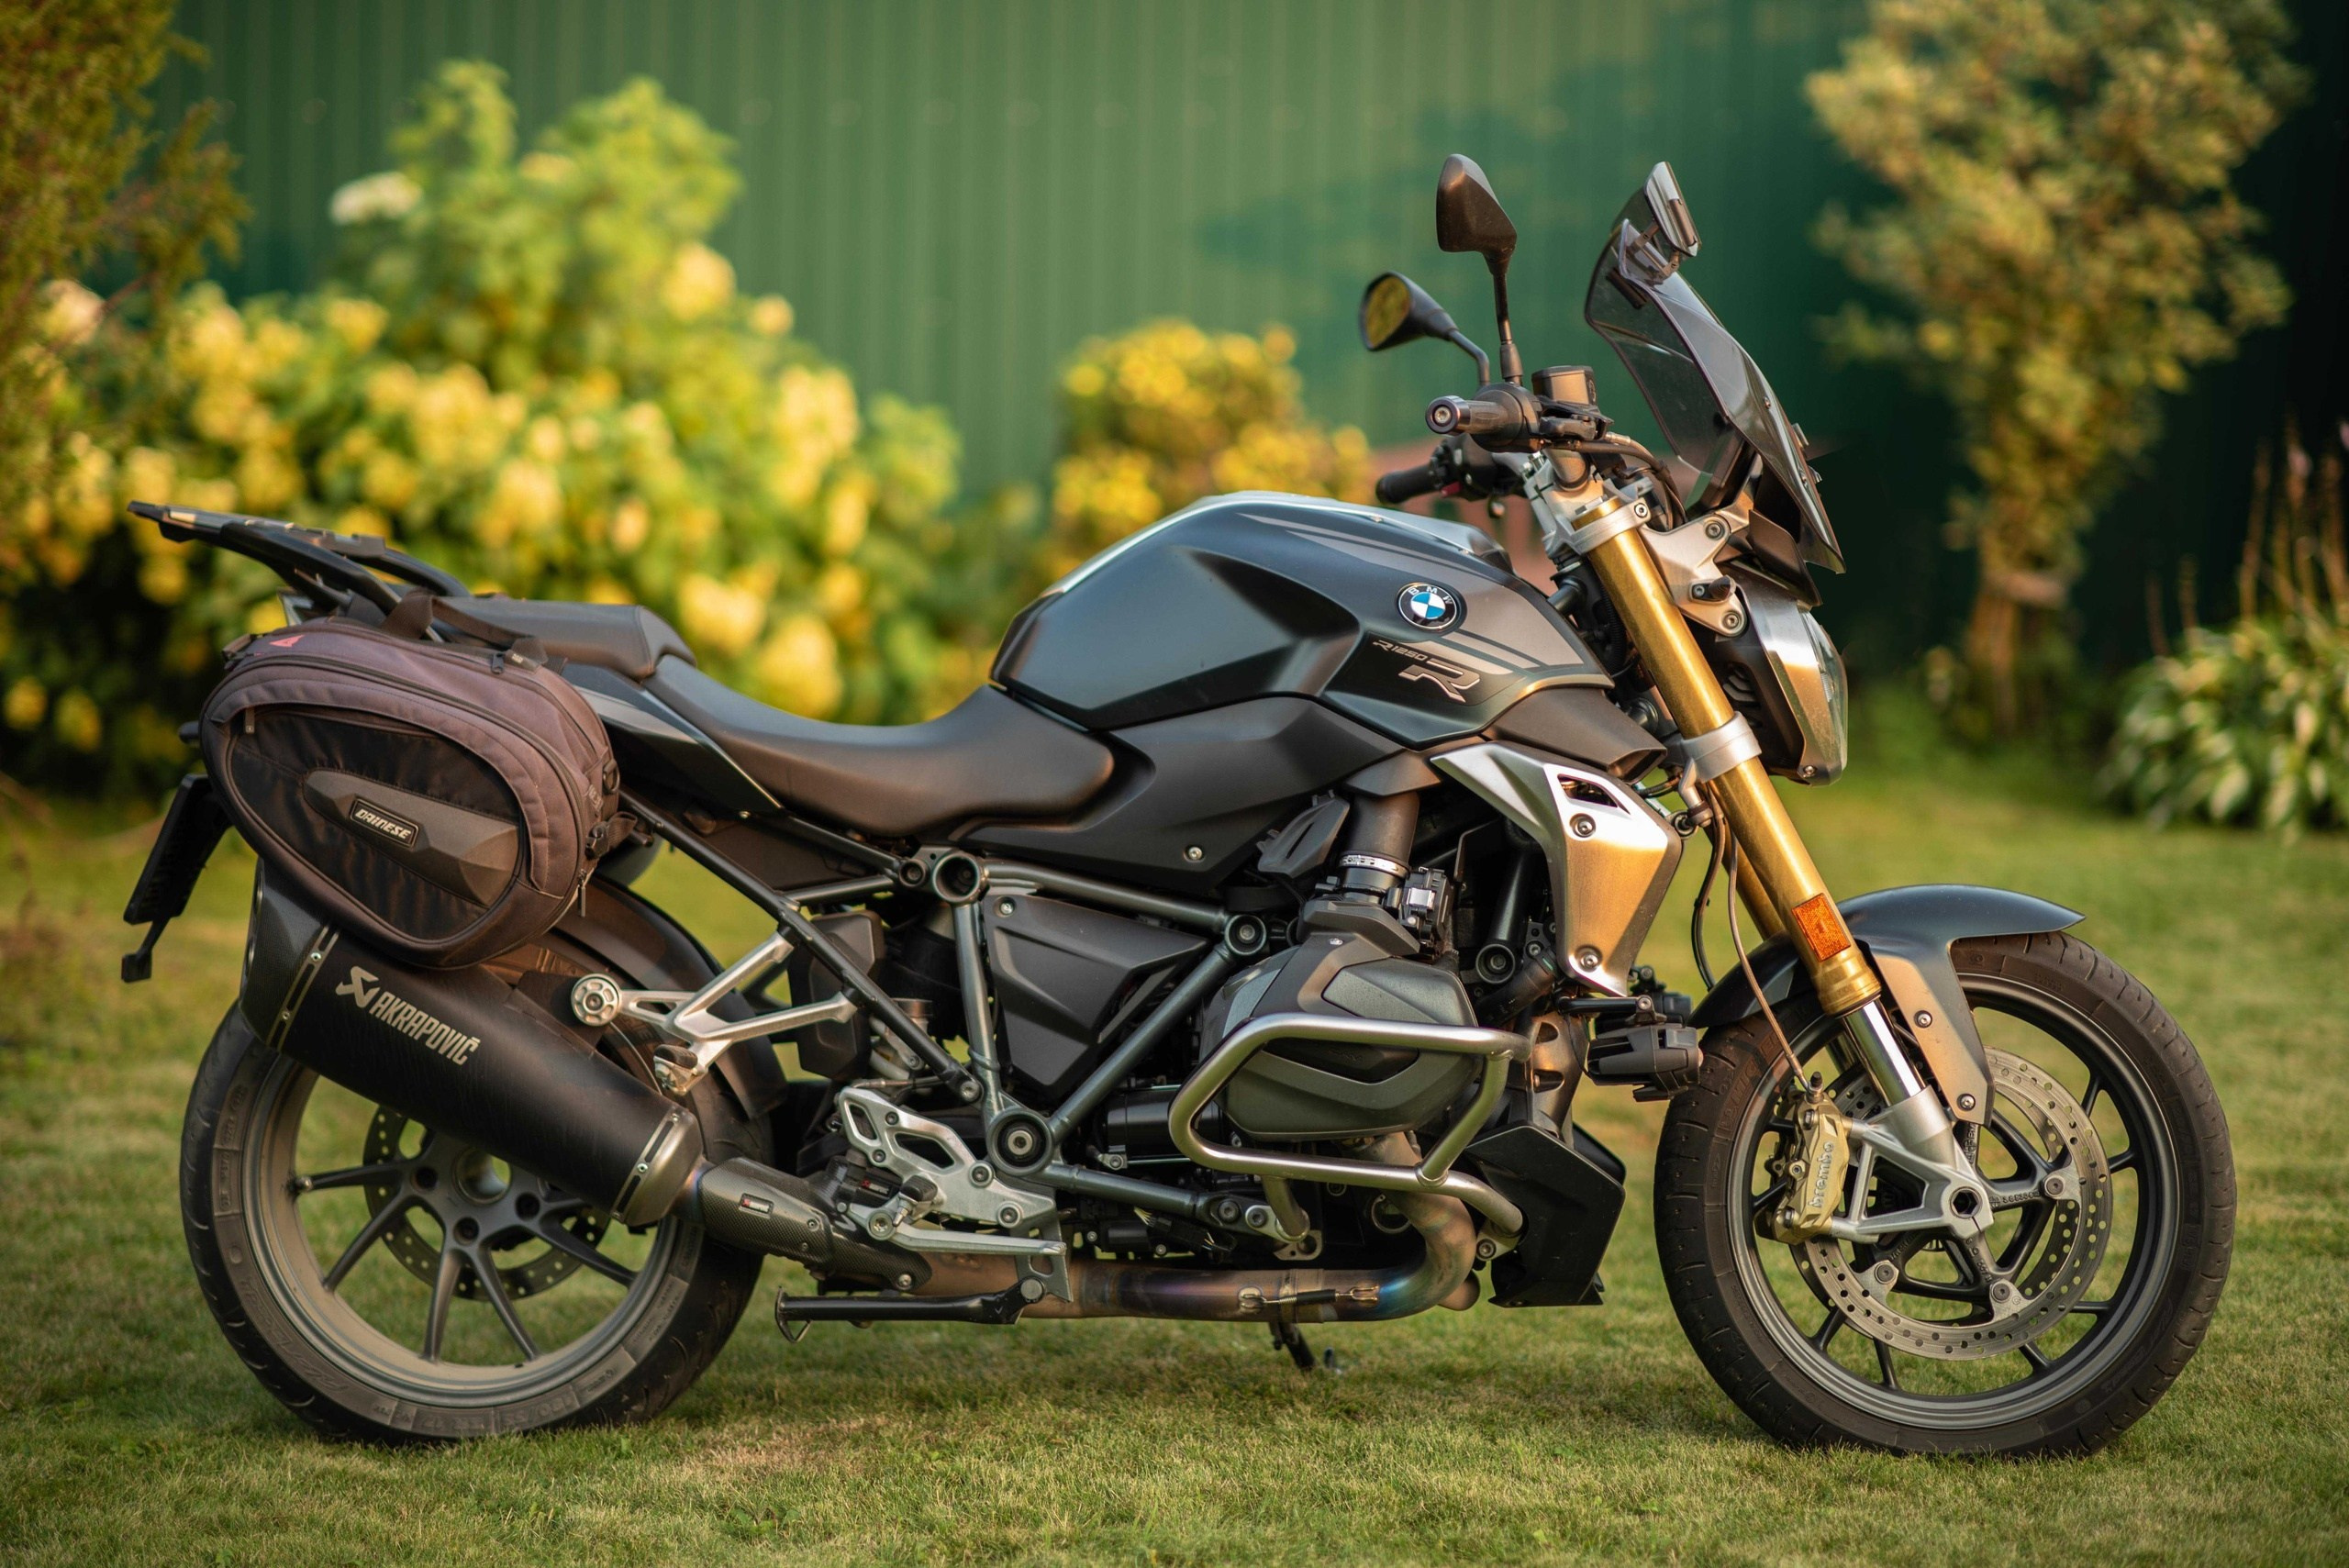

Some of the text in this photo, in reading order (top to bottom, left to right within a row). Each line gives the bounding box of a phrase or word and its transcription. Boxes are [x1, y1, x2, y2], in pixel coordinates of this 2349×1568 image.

[1408, 585, 1453, 604] BMW
[1398, 658, 1480, 703] R
[1808, 1140, 1834, 1208] brembo
